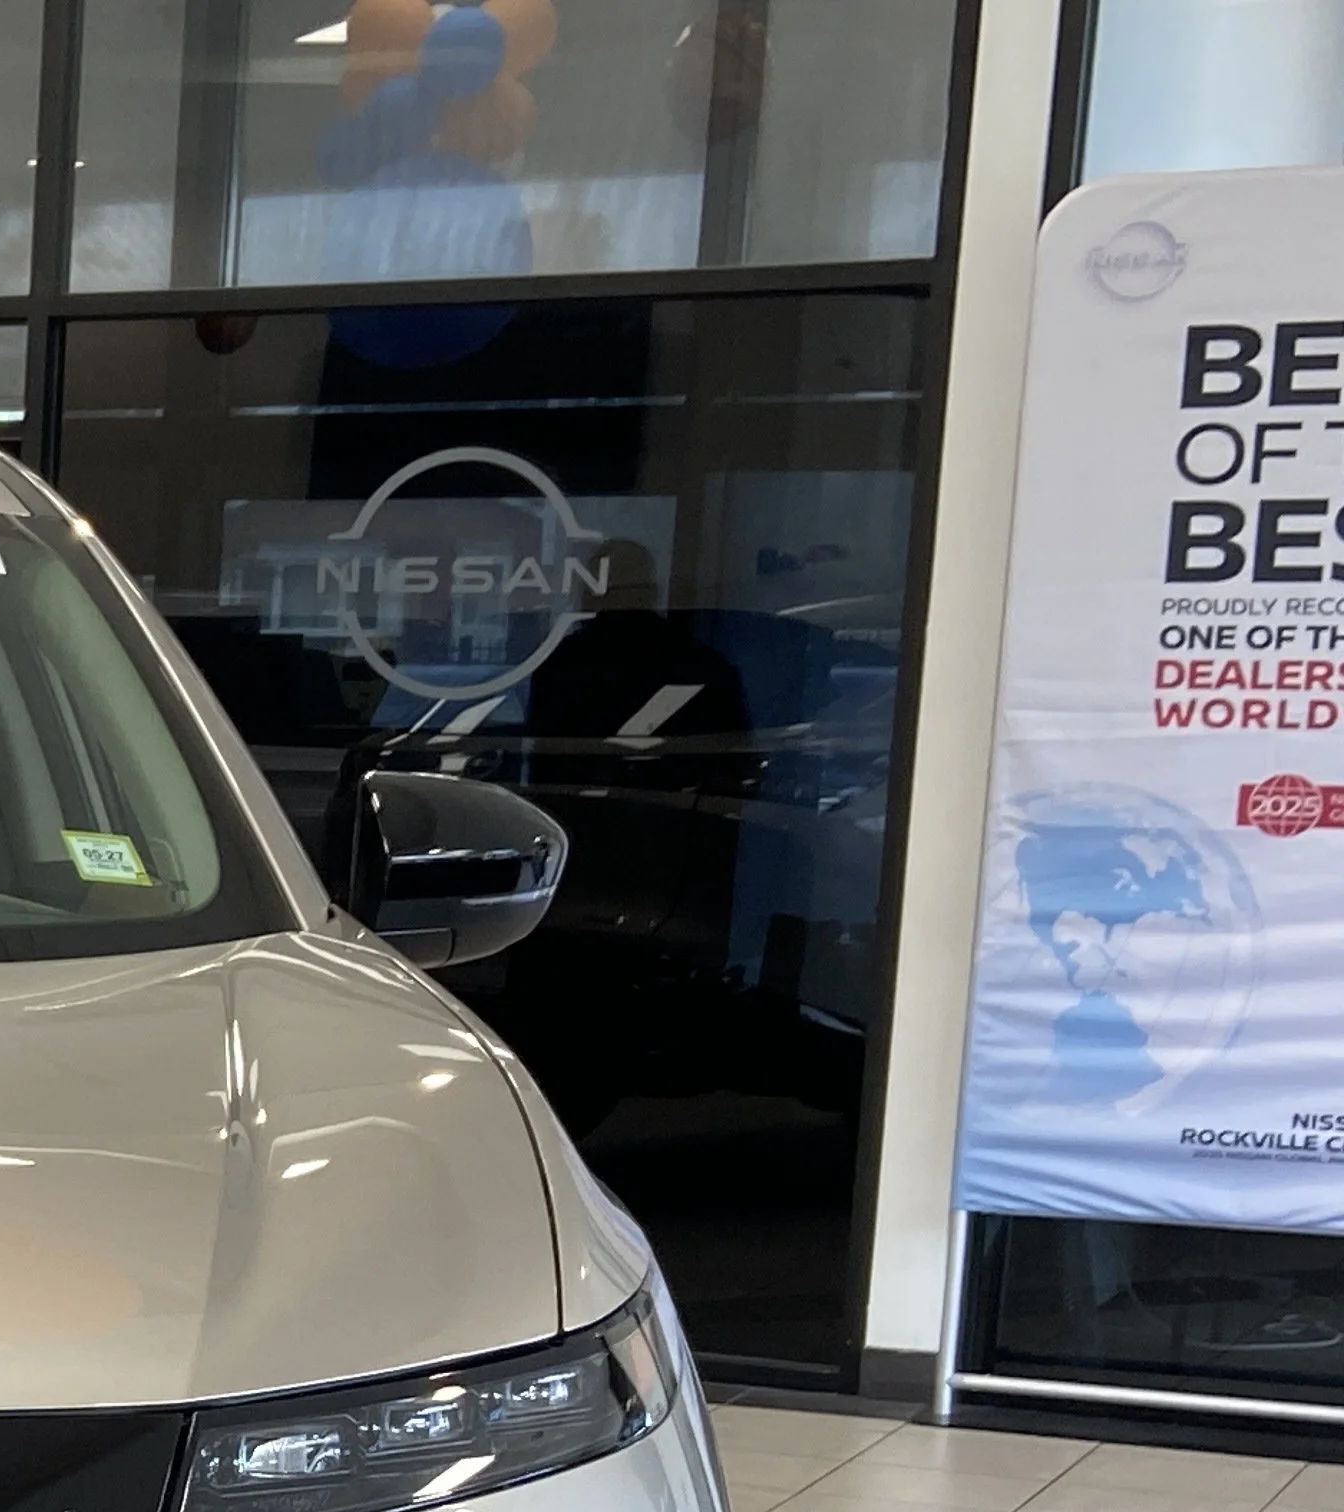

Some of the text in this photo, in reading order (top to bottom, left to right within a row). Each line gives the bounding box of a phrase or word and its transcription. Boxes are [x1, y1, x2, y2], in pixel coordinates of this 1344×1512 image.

[1180, 320, 1344, 409] BE
[1176, 421, 1302, 486] OF
[1164, 498, 1344, 584] BE
[316, 556, 610, 596] NISSAN
[1161, 597, 1278, 616] PROUDLY
[1159, 624, 1238, 650] ONE
[1246, 624, 1298, 650] OF
[1155, 659, 1344, 691] DEALER
[1153, 697, 1339, 729] WORLD
[1249, 795, 1321, 817] 2025
[1180, 1128, 1344, 1153] ROCKVILLE C
